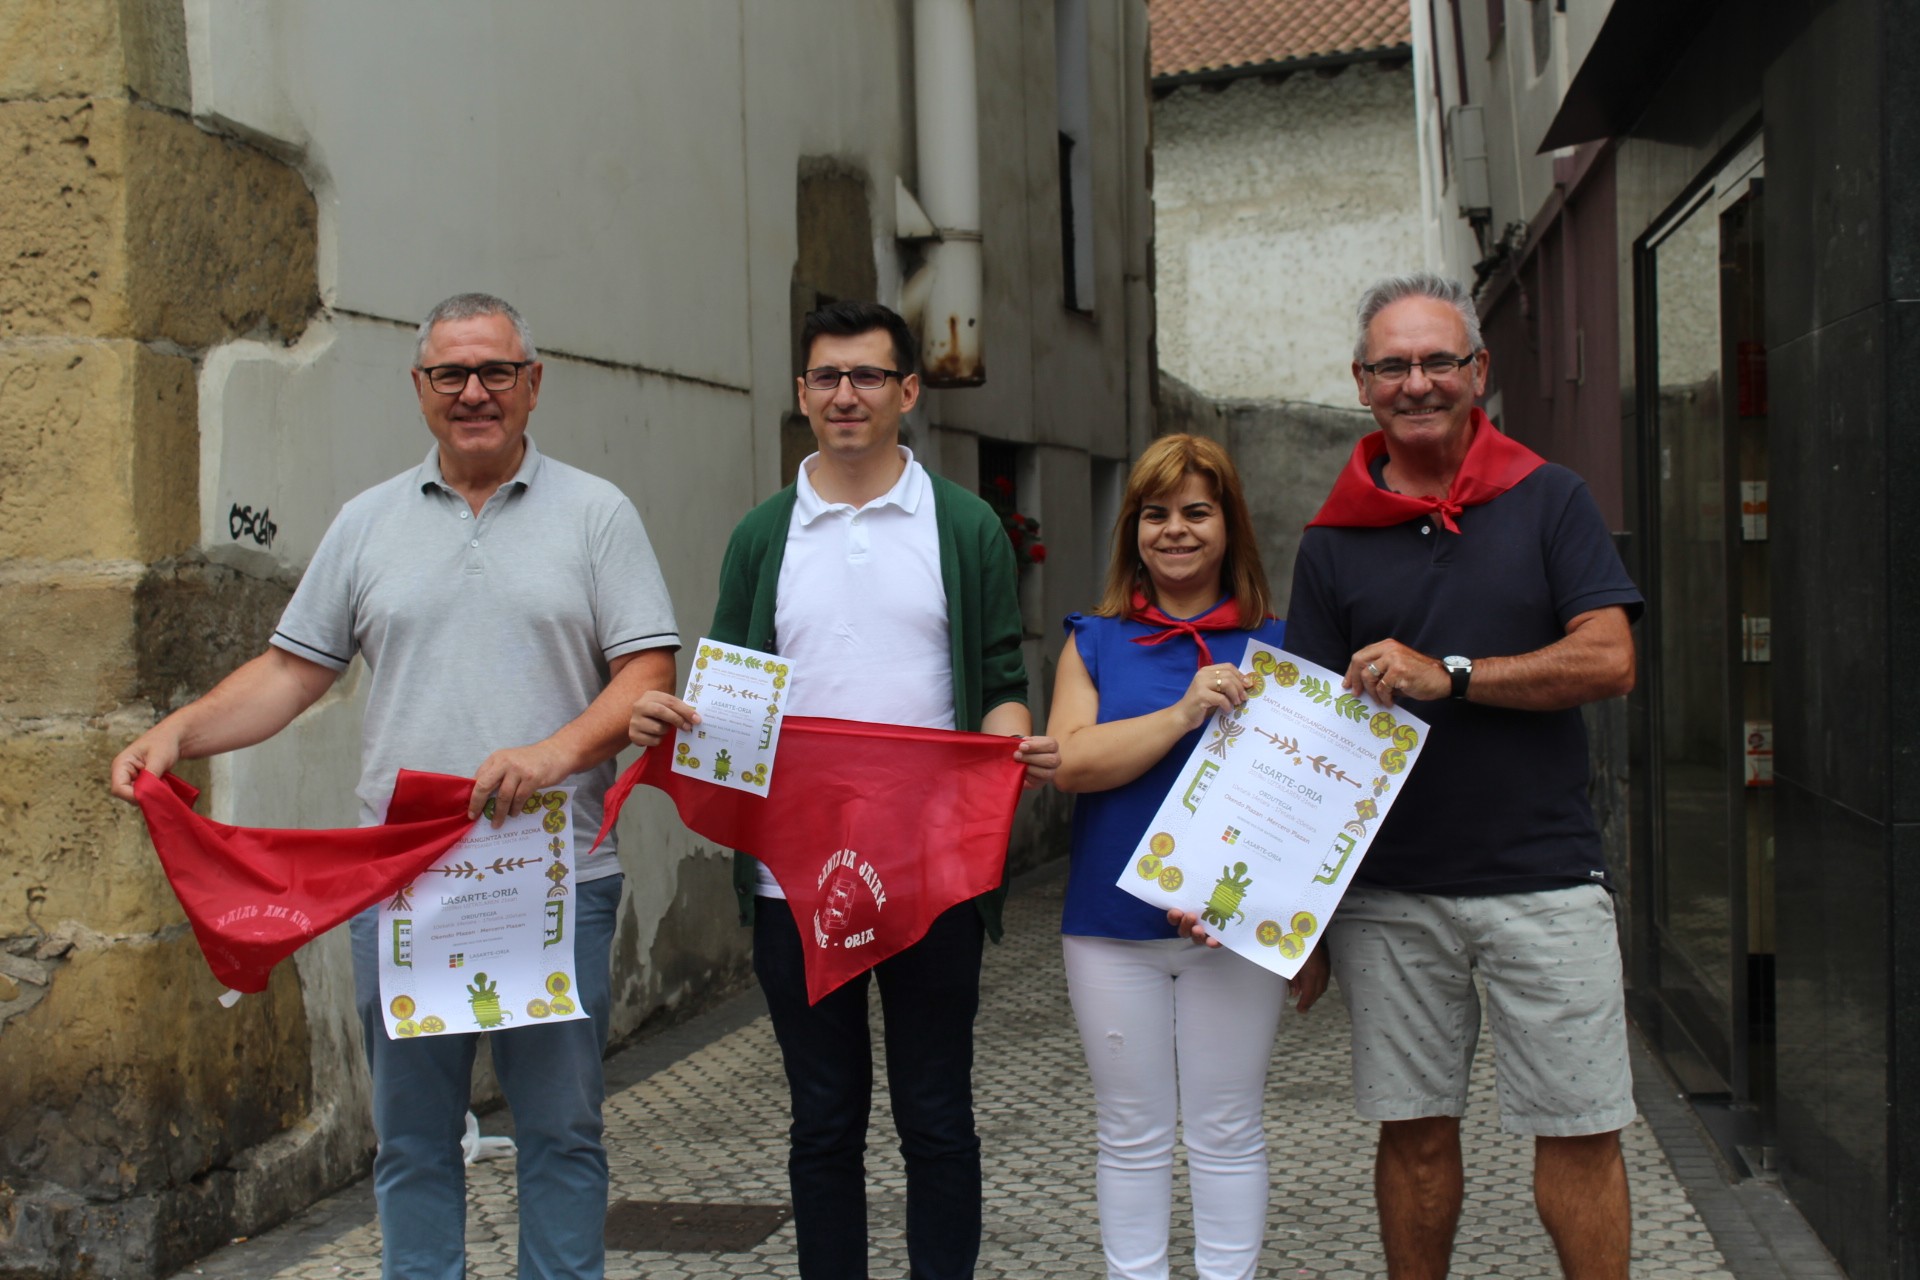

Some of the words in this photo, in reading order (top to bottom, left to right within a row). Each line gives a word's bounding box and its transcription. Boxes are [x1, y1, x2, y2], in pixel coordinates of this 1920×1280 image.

[710, 699, 752, 714] LASARTE-ORIA
[1262, 694, 1281, 709] SANTA
[1280, 704, 1293, 714] ANA
[1356, 745, 1377, 760] AZOKA
[1252, 759, 1324, 805] LASARTE-ORIA
[1257, 788, 1293, 812] ORDUTEGIA
[520, 827, 540, 835] AZOKA
[1290, 830, 1311, 844] Plazan
[440, 887, 518, 905] LASARTE-ORIA
[460, 910, 497, 920] ORDUTEGIA
